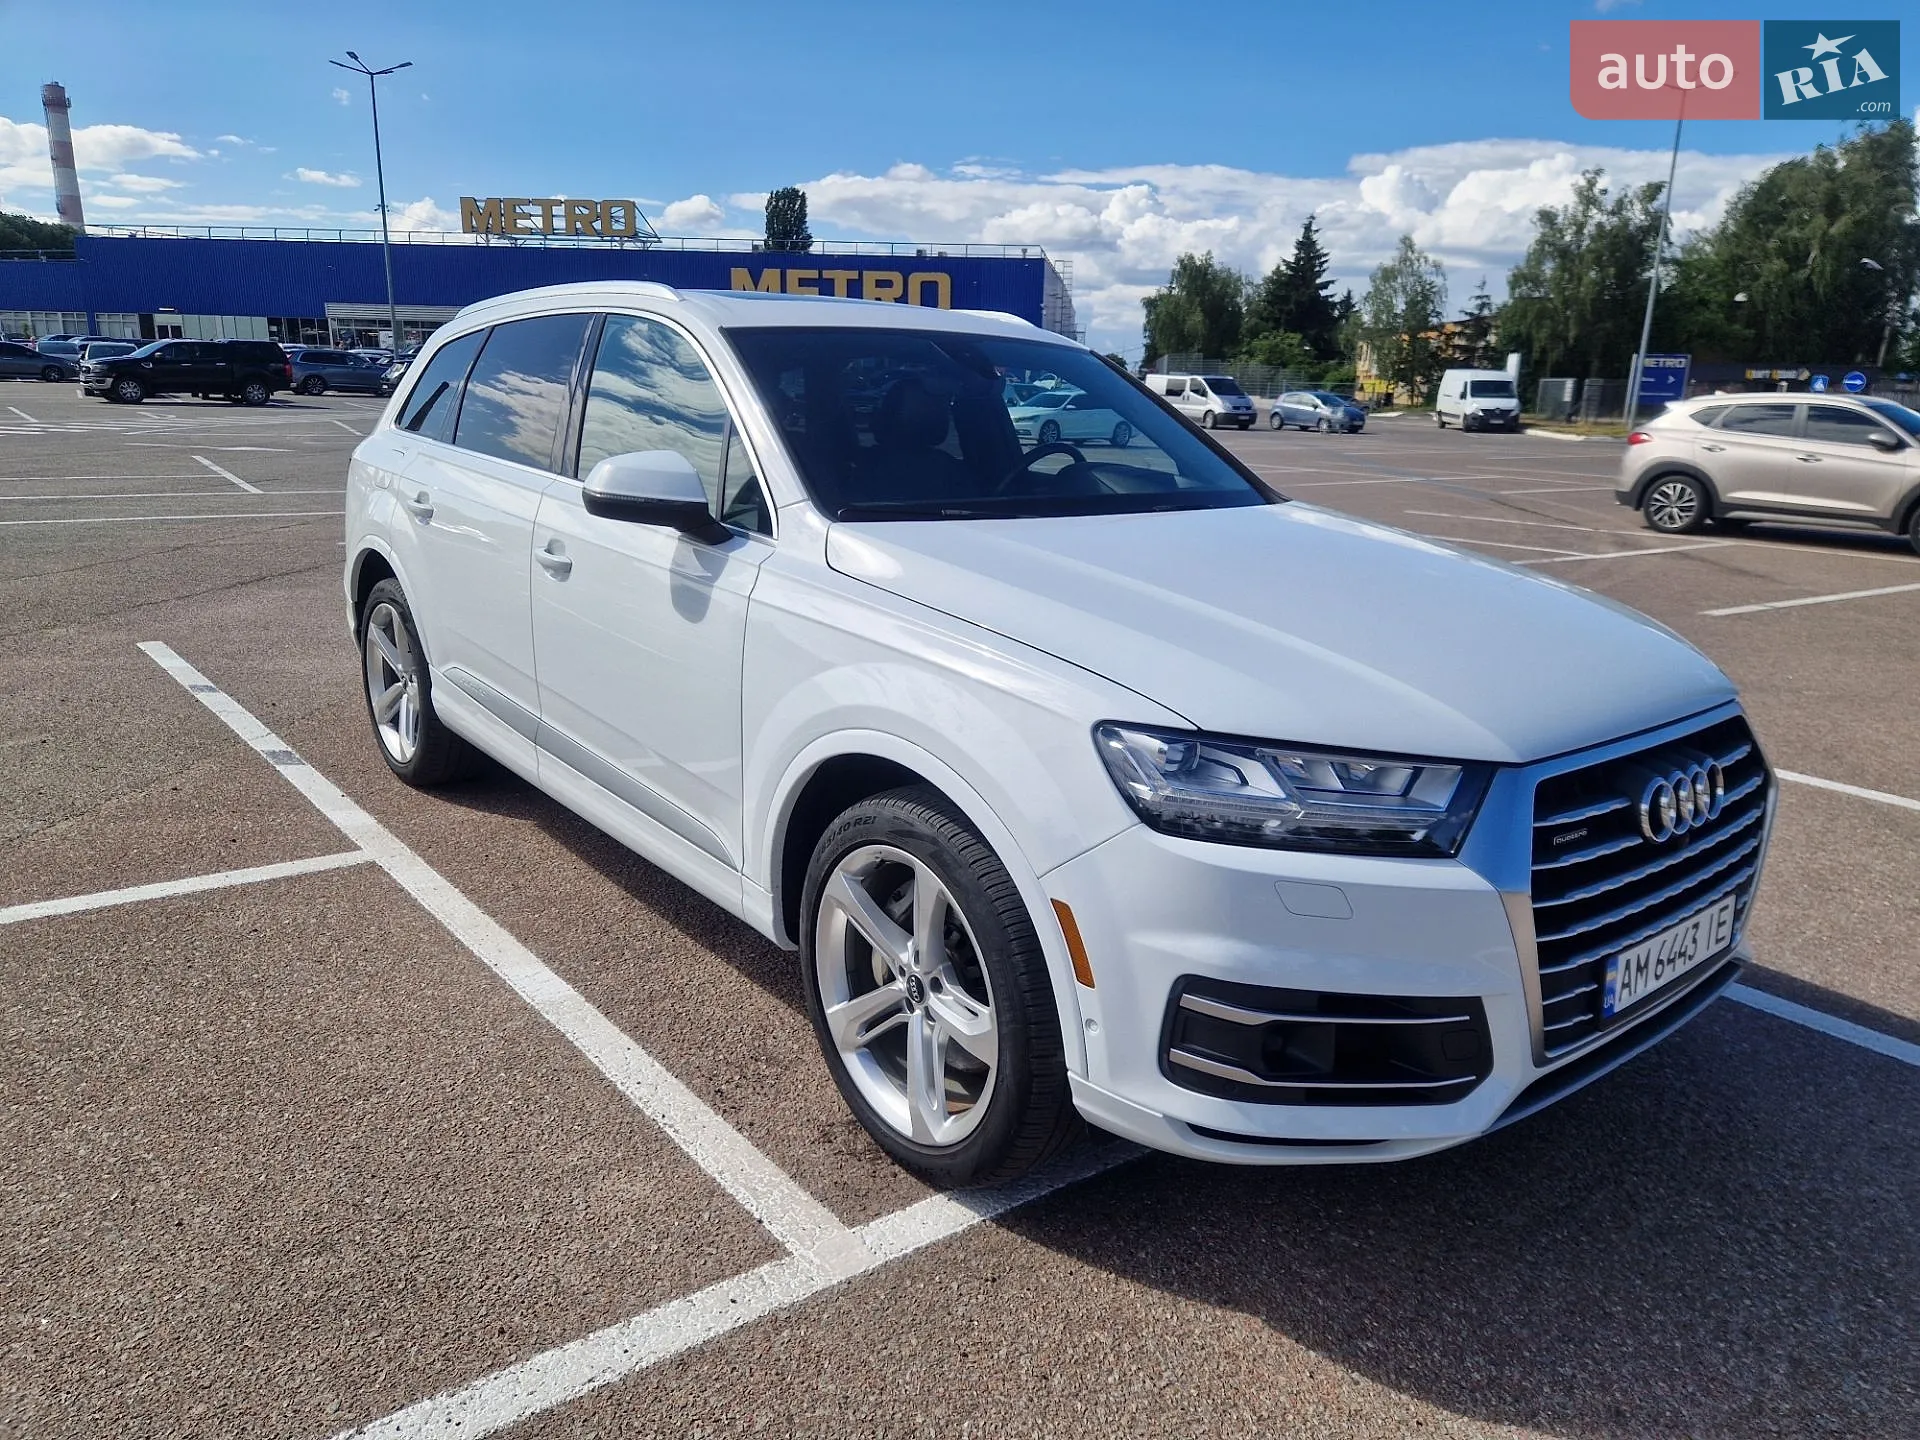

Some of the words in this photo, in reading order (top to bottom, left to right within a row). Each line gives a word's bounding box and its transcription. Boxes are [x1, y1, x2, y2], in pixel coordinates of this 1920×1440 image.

[460, 197, 636, 236] METRO
[730, 267, 951, 310] METRO
[1618, 948, 1651, 1003] AM
[1654, 922, 1700, 981] 6443
[1707, 904, 1730, 952] IE
